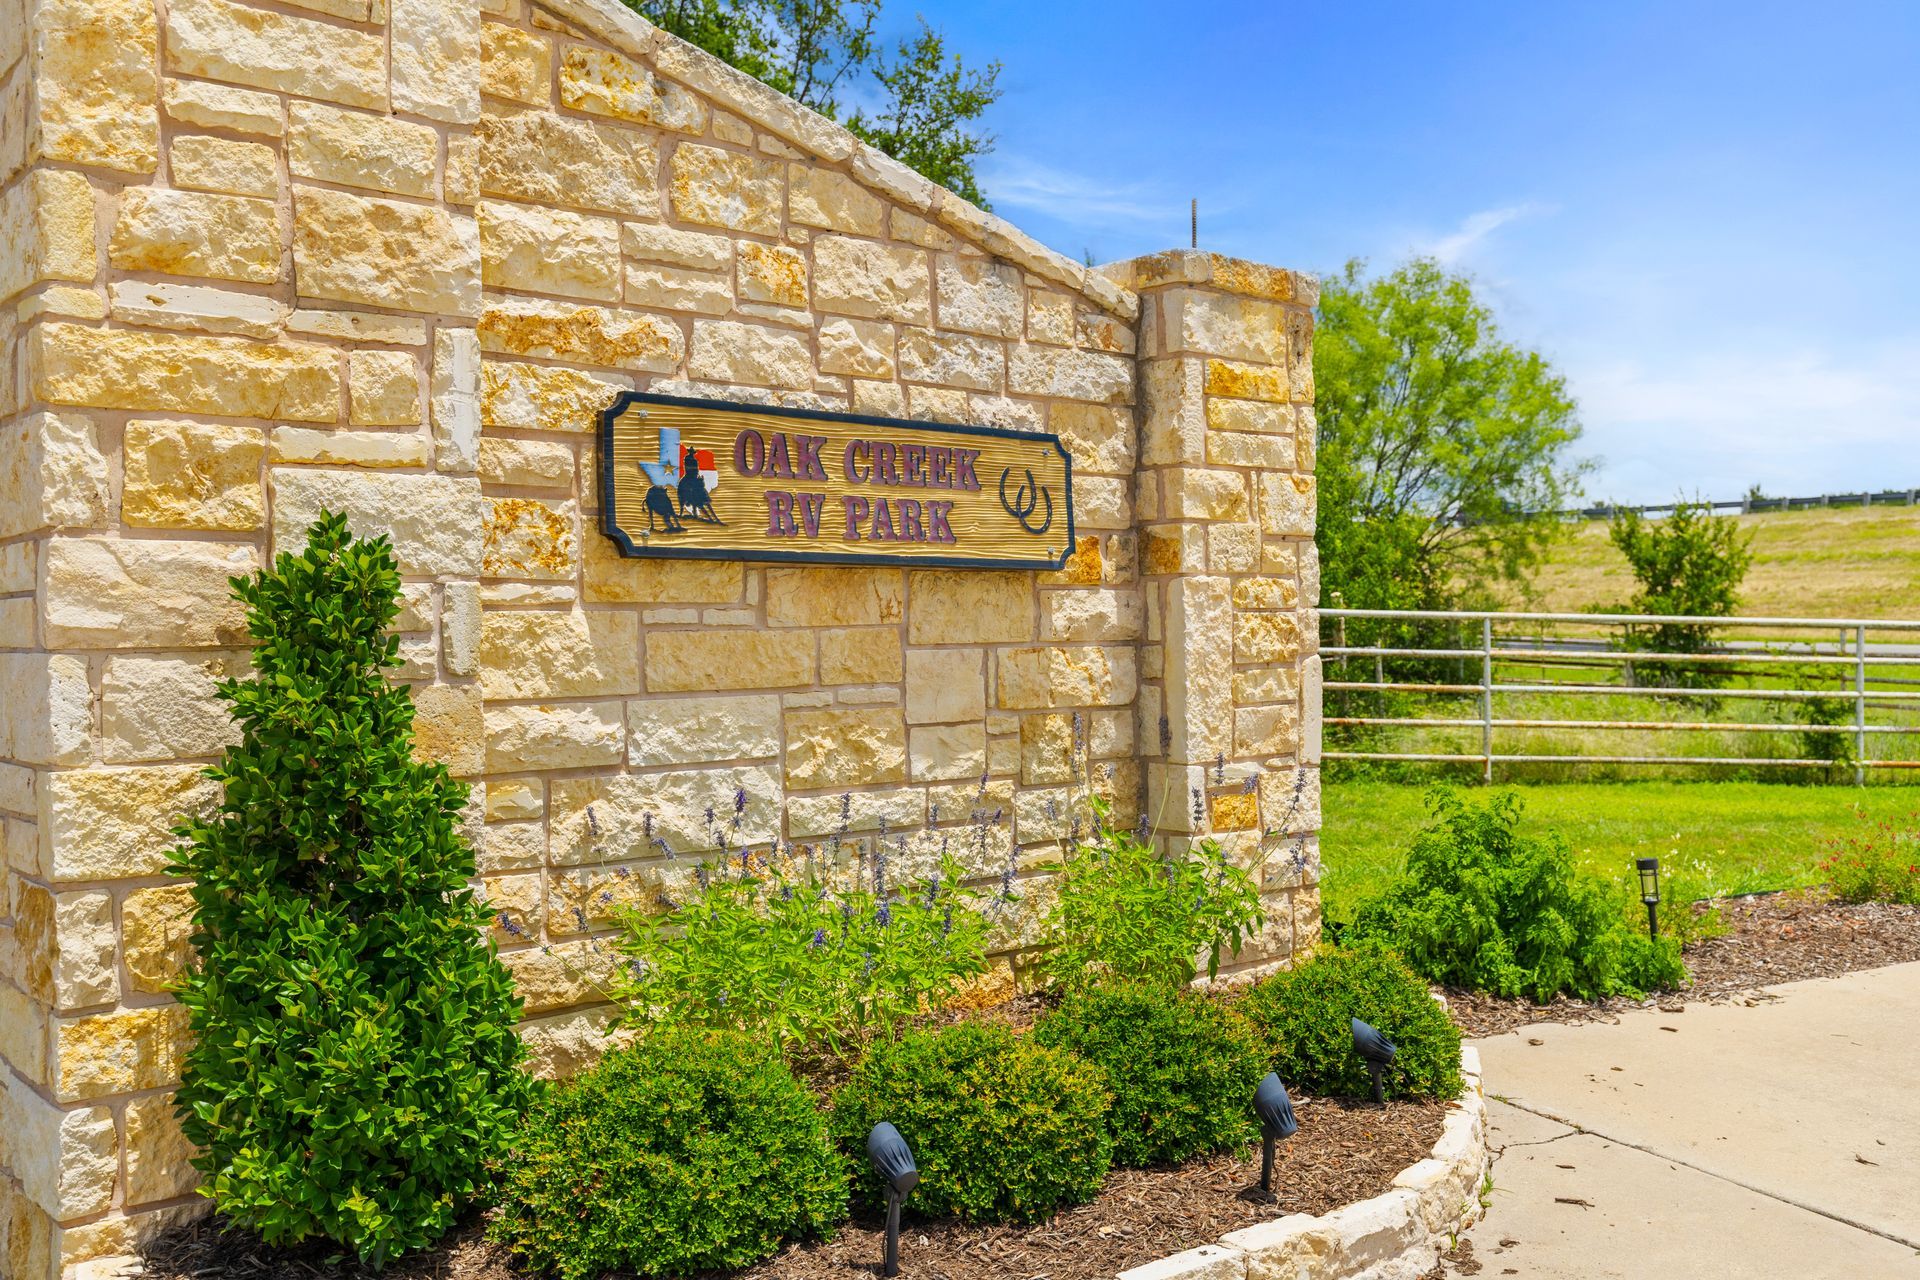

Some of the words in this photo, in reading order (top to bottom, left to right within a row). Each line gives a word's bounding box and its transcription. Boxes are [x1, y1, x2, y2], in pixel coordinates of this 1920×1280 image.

[733, 429, 828, 482] OAK
[843, 439, 982, 491] CREEK
[765, 490, 826, 539] RV
[842, 495, 957, 544] PARK
